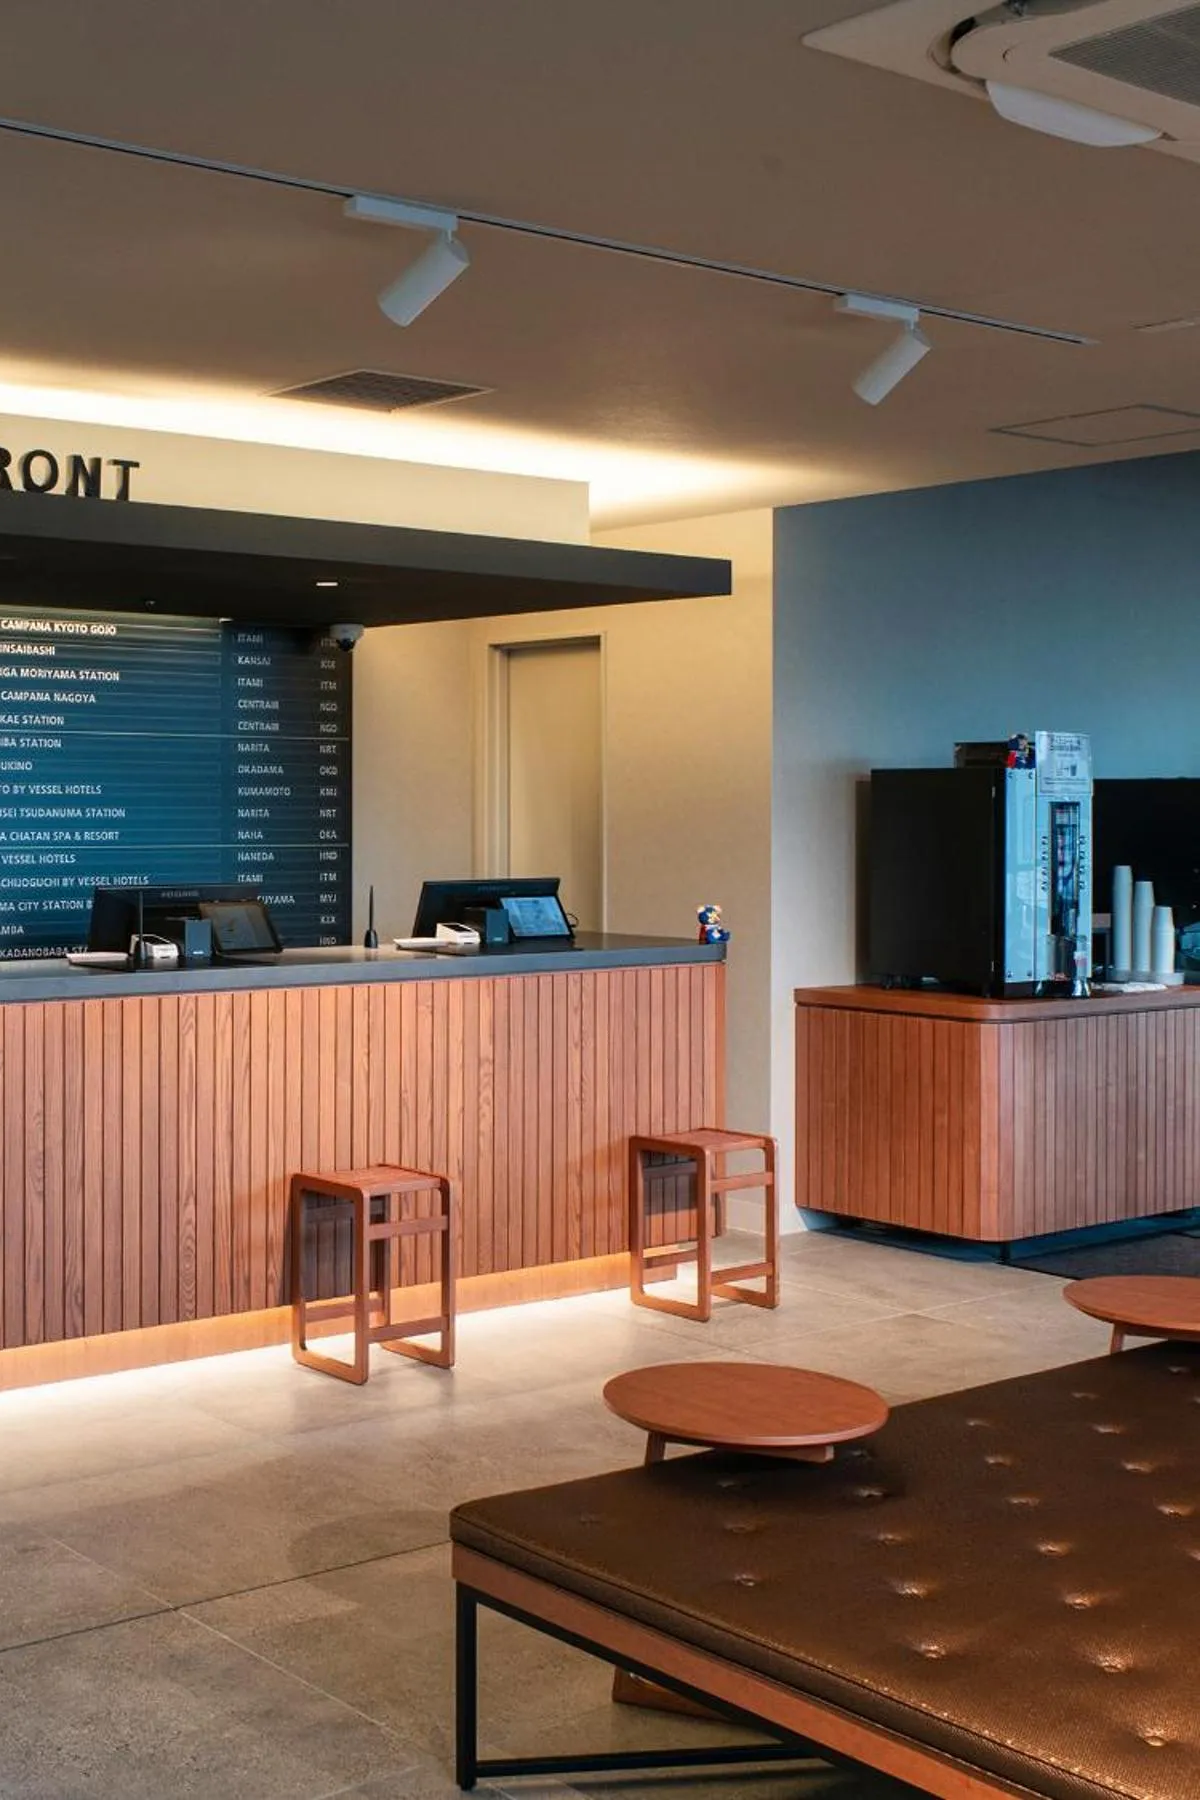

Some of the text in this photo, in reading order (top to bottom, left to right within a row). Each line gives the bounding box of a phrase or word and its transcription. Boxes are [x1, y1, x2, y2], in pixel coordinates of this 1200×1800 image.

[1, 619, 50, 632] CAMPANA
[54, 622, 87, 634] KYOTO
[90, 624, 116, 635] GOJO
[21, 668, 76, 679] MORIYAMA
[79, 671, 119, 681] STATION
[1, 691, 50, 701] CAMPANA
[54, 692, 96, 703] NAGOYA
[22, 715, 64, 725] STATION
[20, 738, 61, 748] STATION
[20, 808, 82, 817] TSUDANUMA
[85, 808, 125, 818] STATION
[10, 832, 50, 841] CHATAN
[53, 831, 72, 840] SPA
[84, 831, 119, 840] RESORT
